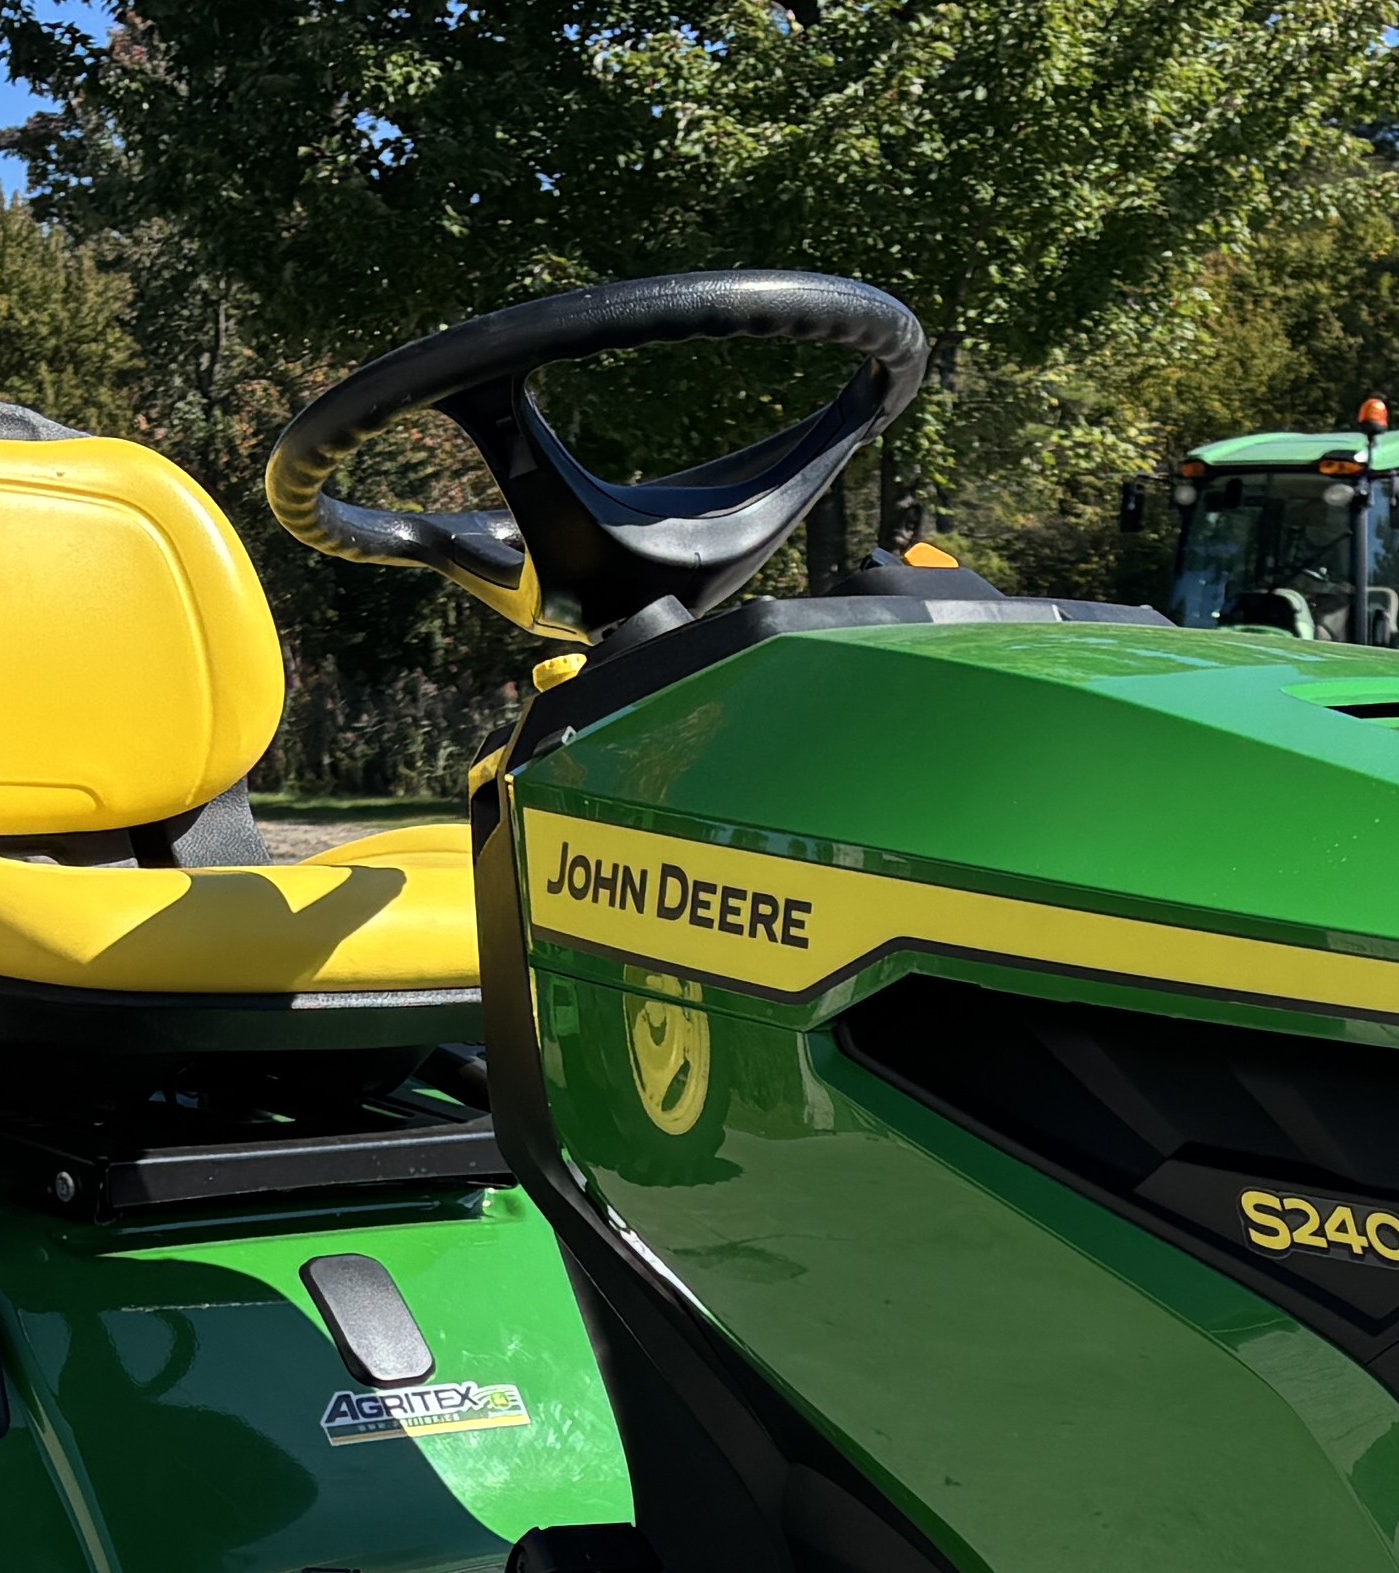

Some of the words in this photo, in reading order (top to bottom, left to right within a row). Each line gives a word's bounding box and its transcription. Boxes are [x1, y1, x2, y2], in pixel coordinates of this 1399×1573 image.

[547, 841, 648, 915] JOHN
[656, 863, 812, 949] DEERE
[325, 1386, 479, 1424] AGRITEX
